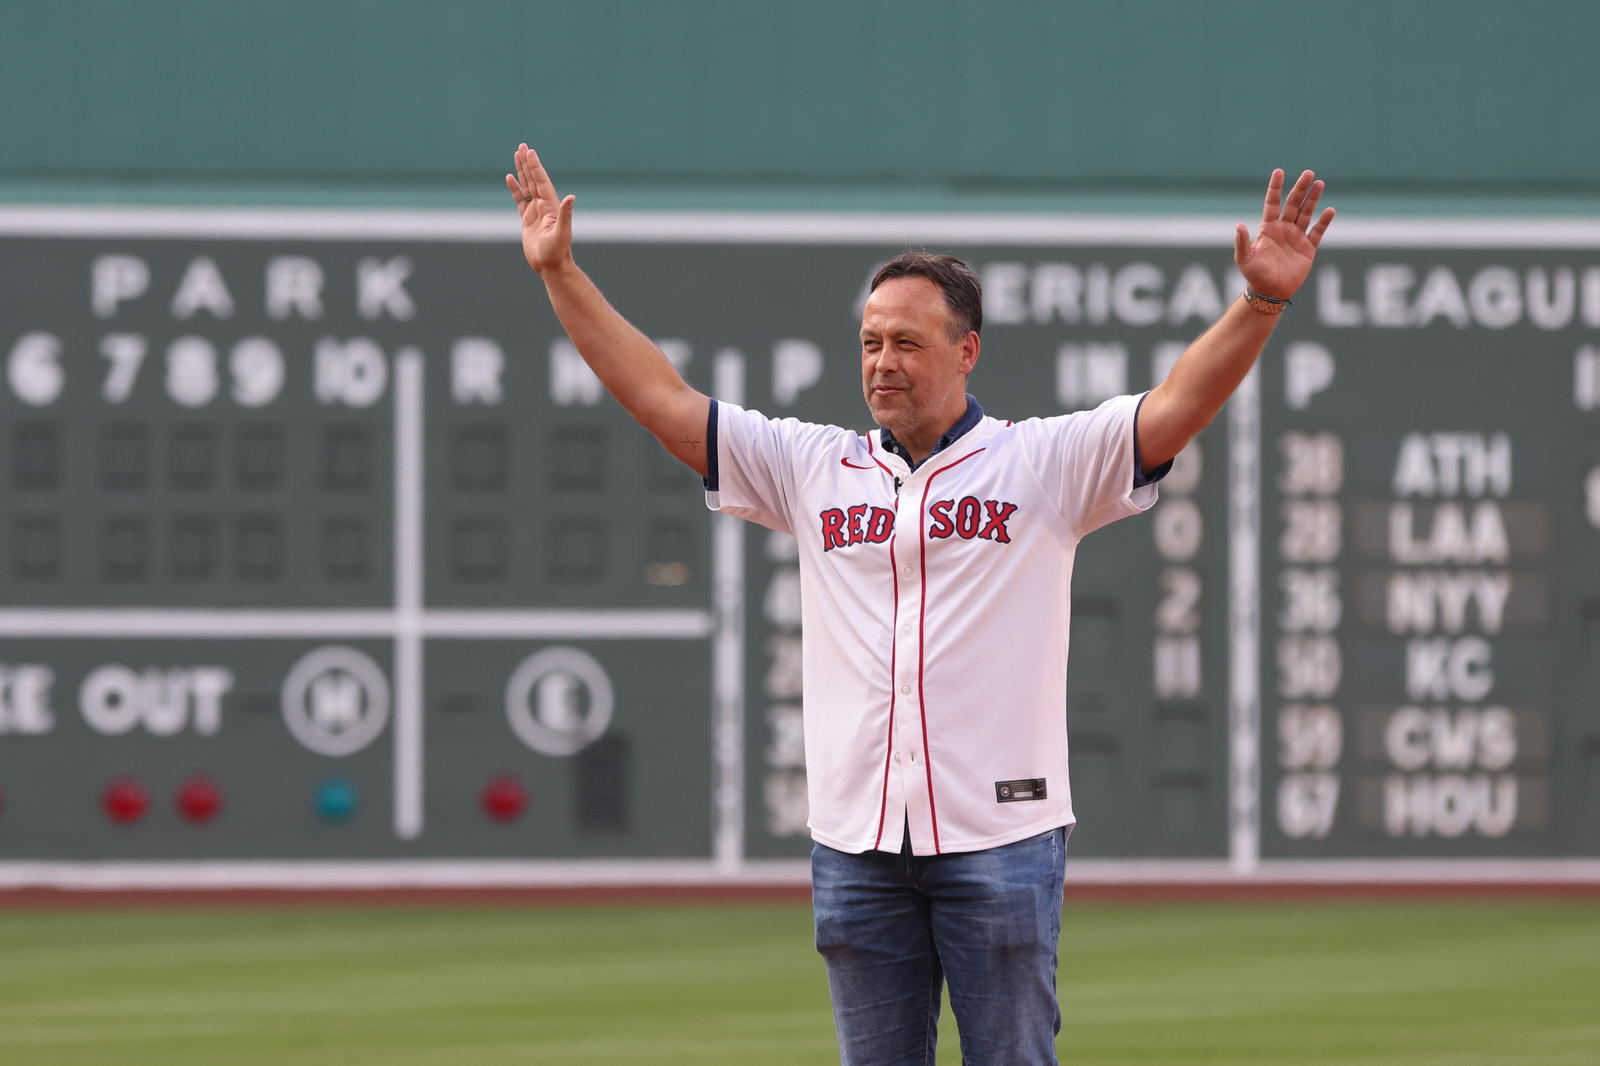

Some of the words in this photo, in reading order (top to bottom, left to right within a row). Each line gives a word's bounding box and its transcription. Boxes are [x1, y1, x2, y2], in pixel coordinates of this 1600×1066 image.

[91, 254, 416, 321] PARK
[6, 331, 65, 407] 6
[99, 333, 149, 404] 7
[164, 335, 220, 408] 8
[228, 336, 286, 408] 9
[312, 336, 389, 408] 10
[450, 336, 506, 406] R
[771, 338, 824, 407] P
[1283, 341, 1337, 411] P
[1392, 431, 1513, 498] ATH
[820, 503, 896, 552] RED
[928, 495, 1018, 544] SOX
[1154, 501, 1202, 562] 0
[1386, 500, 1511, 564] LAA
[1155, 568, 1202, 632] 2
[1384, 570, 1513, 634] NYY
[78, 664, 235, 736] OUT
[1405, 636, 1495, 701] KC
[1382, 705, 1518, 770] CWS
[1381, 773, 1519, 838] HOU
